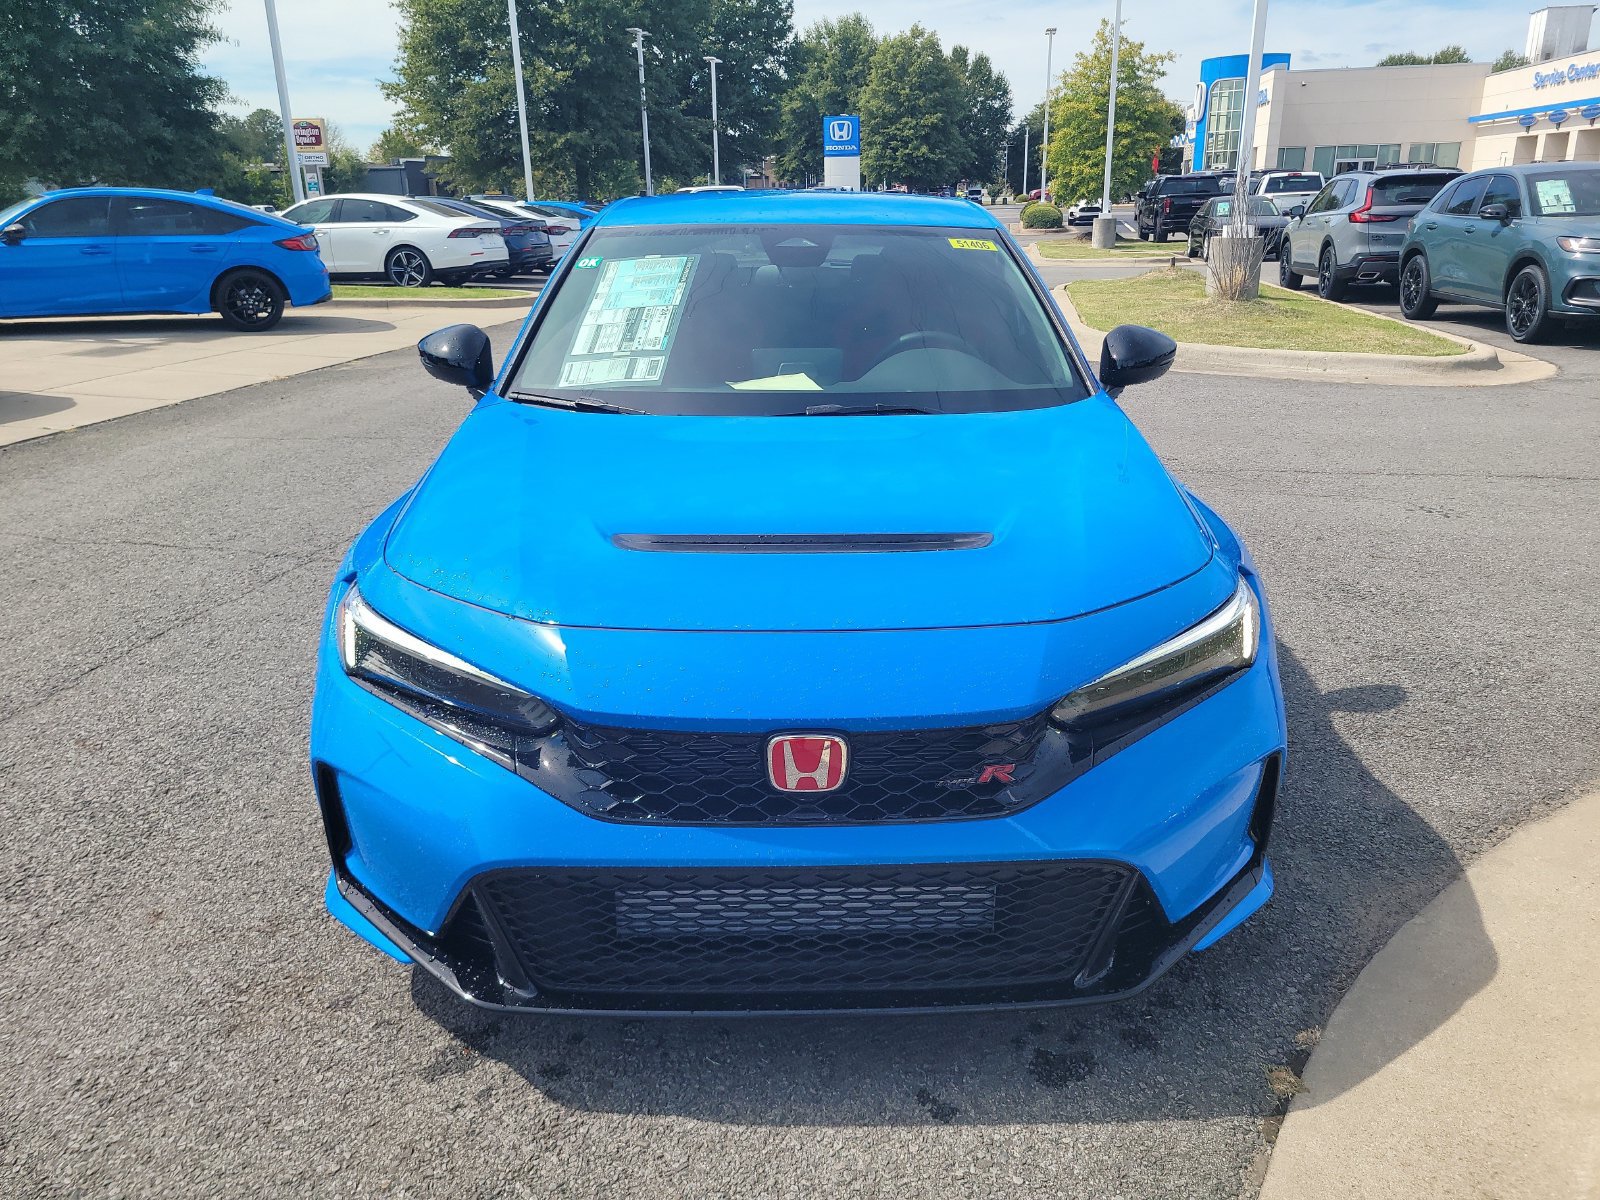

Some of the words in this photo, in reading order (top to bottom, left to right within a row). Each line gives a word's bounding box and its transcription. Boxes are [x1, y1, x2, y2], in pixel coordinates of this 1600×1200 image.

[1534, 72, 1564, 87] Service
[294, 127, 319, 136] ovington
[296, 136, 316, 145] Square
[956, 240, 991, 249] 51406
[578, 258, 599, 267] OK
[979, 764, 1015, 782] R
